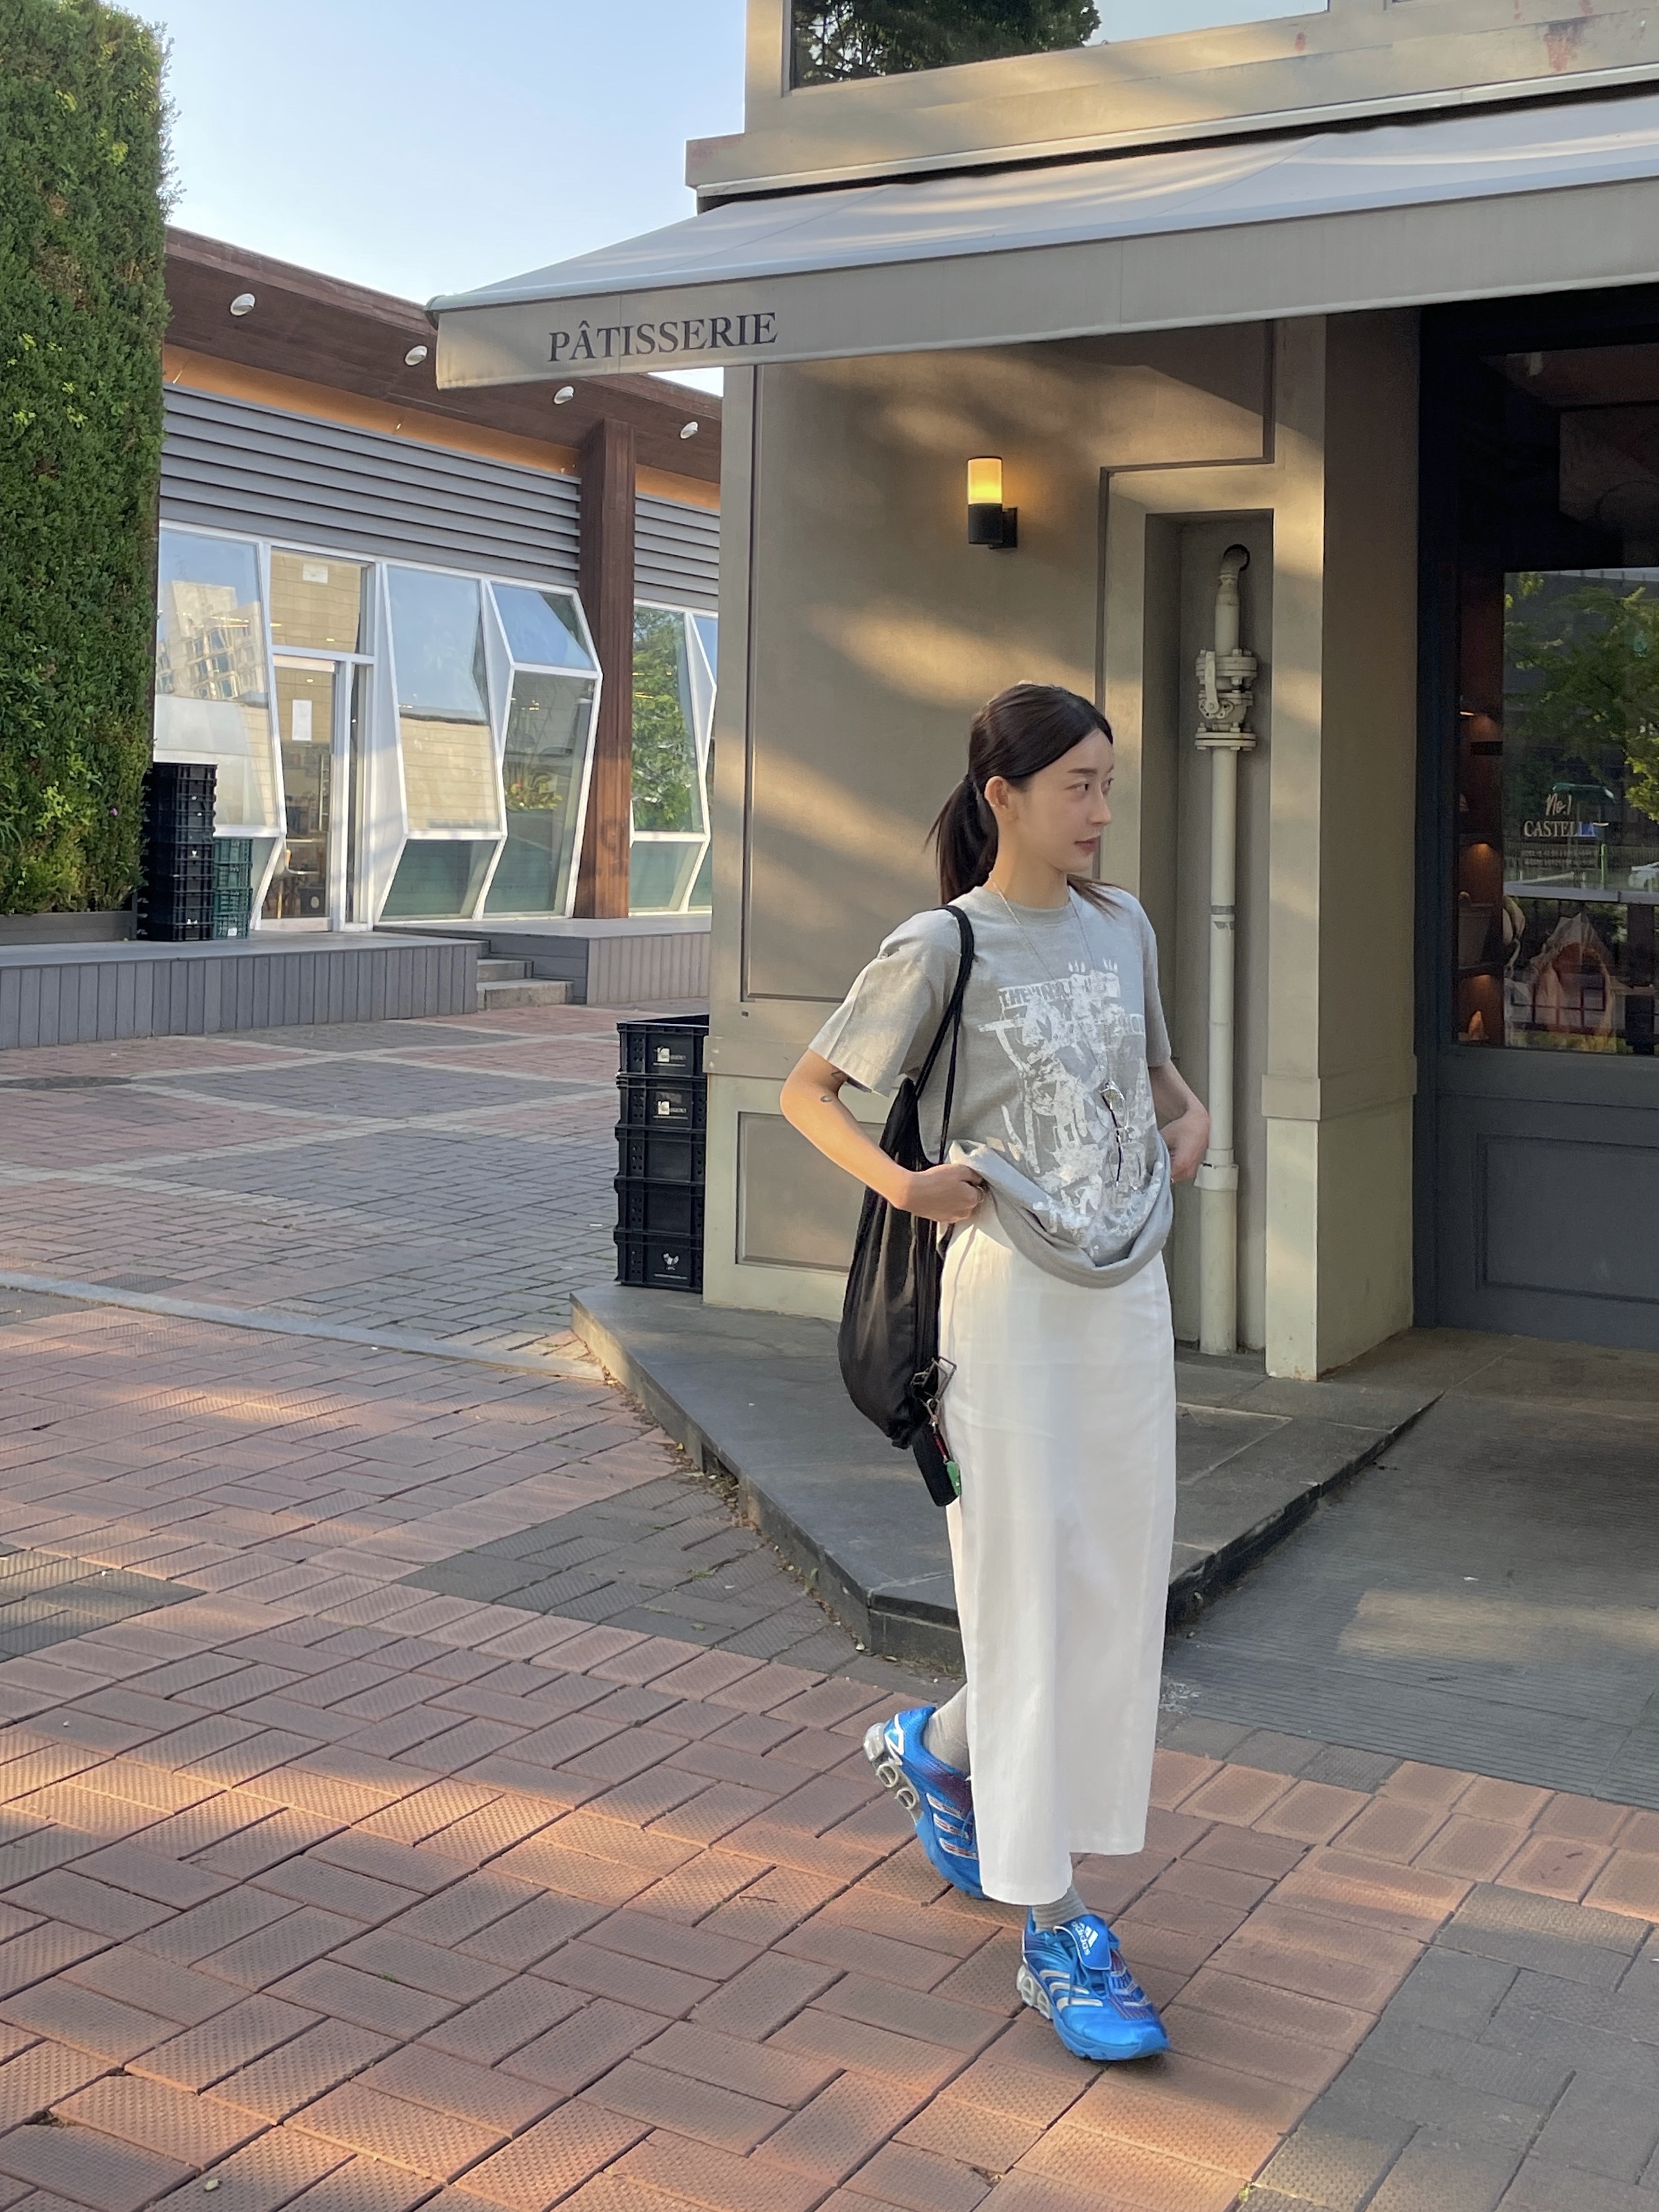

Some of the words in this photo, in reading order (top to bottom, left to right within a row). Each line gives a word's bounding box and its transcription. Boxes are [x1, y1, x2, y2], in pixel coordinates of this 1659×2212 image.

[548, 312, 778, 362] PÂTISSERIE
[1524, 820, 1596, 837] CASTELLA
[1071, 1921, 1090, 1956] adidas
